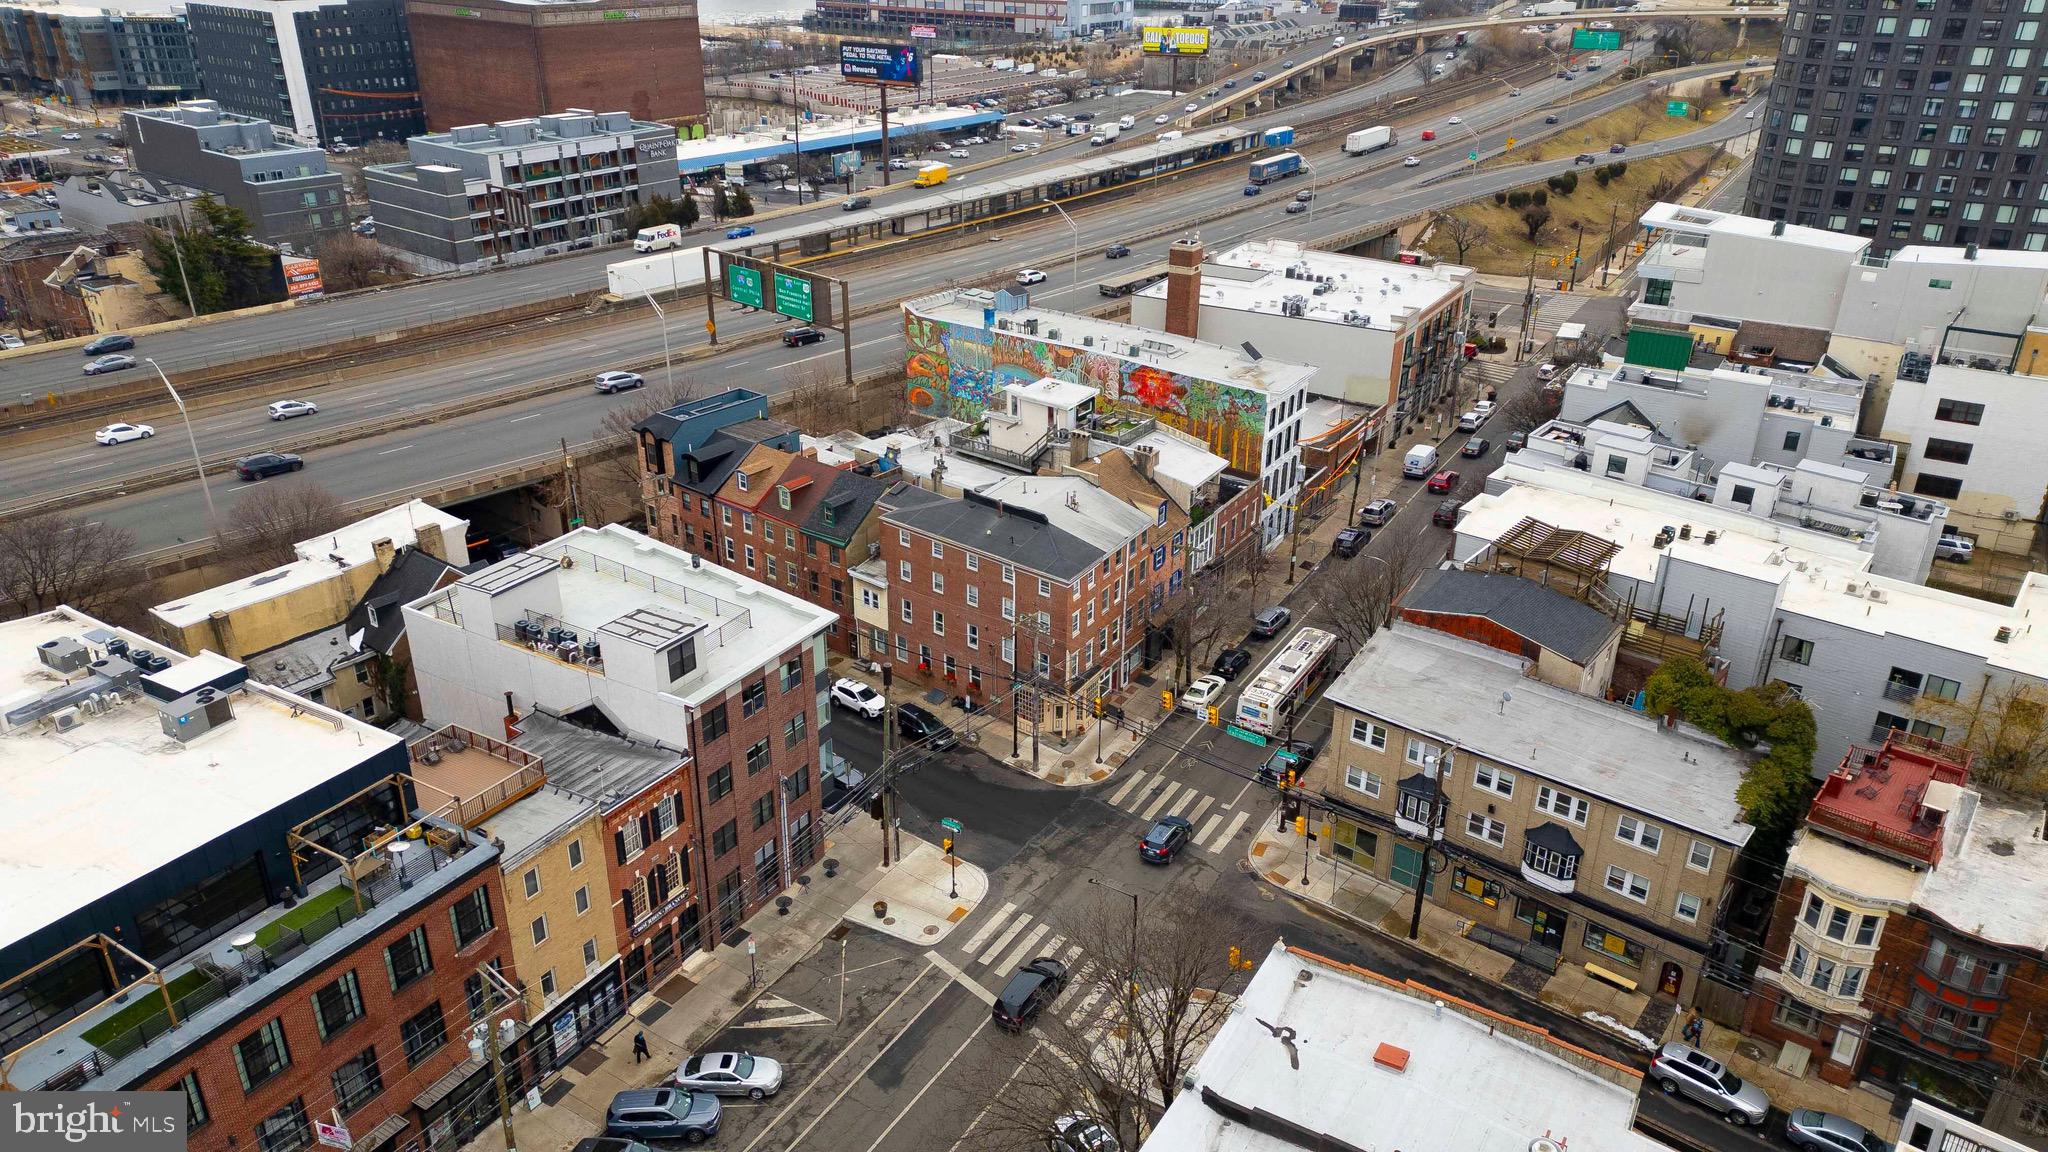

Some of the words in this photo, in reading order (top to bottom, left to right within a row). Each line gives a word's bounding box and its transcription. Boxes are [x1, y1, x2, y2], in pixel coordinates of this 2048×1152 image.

[876, 54, 893, 62] METAL
[851, 64, 877, 74] Rewards
[650, 149, 667, 158] BANK
[656, 228, 678, 239] FedEx
